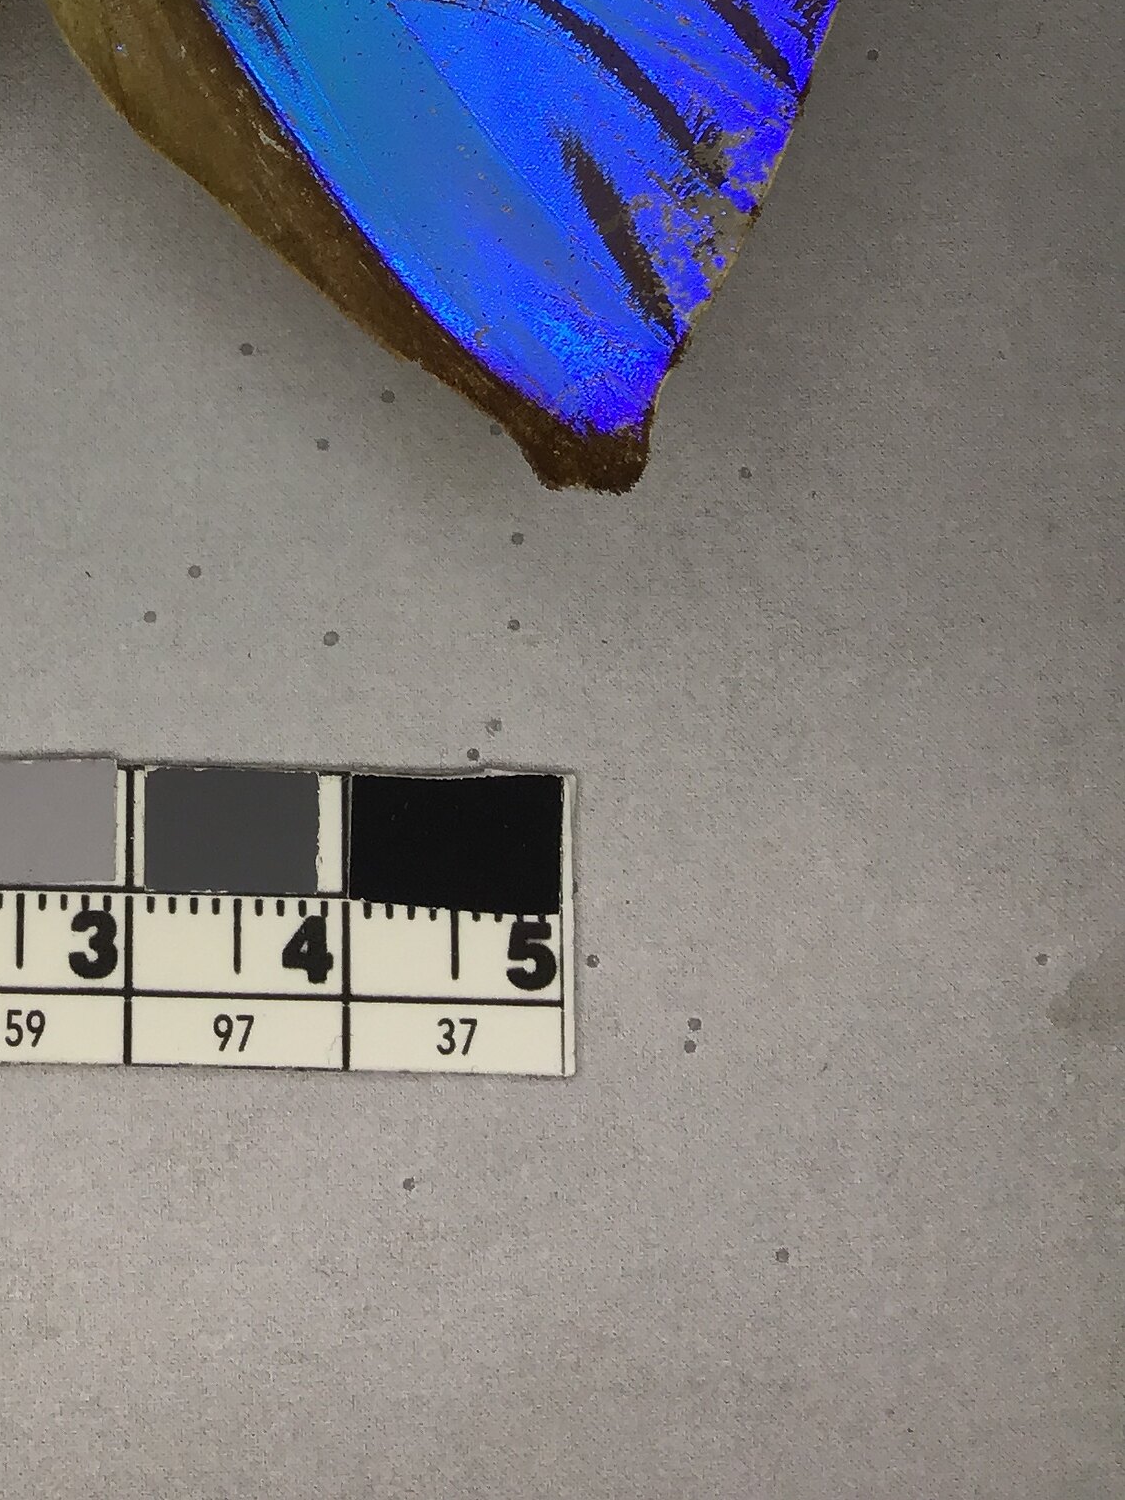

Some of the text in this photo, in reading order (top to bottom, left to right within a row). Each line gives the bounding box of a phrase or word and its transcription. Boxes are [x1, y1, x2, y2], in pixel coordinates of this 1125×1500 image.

[68, 910, 118, 979] 3
[281, 915, 334, 984] 4
[506, 922, 557, 990] 5
[213, 1013, 255, 1052] 97
[436, 1017, 478, 1055] 37
